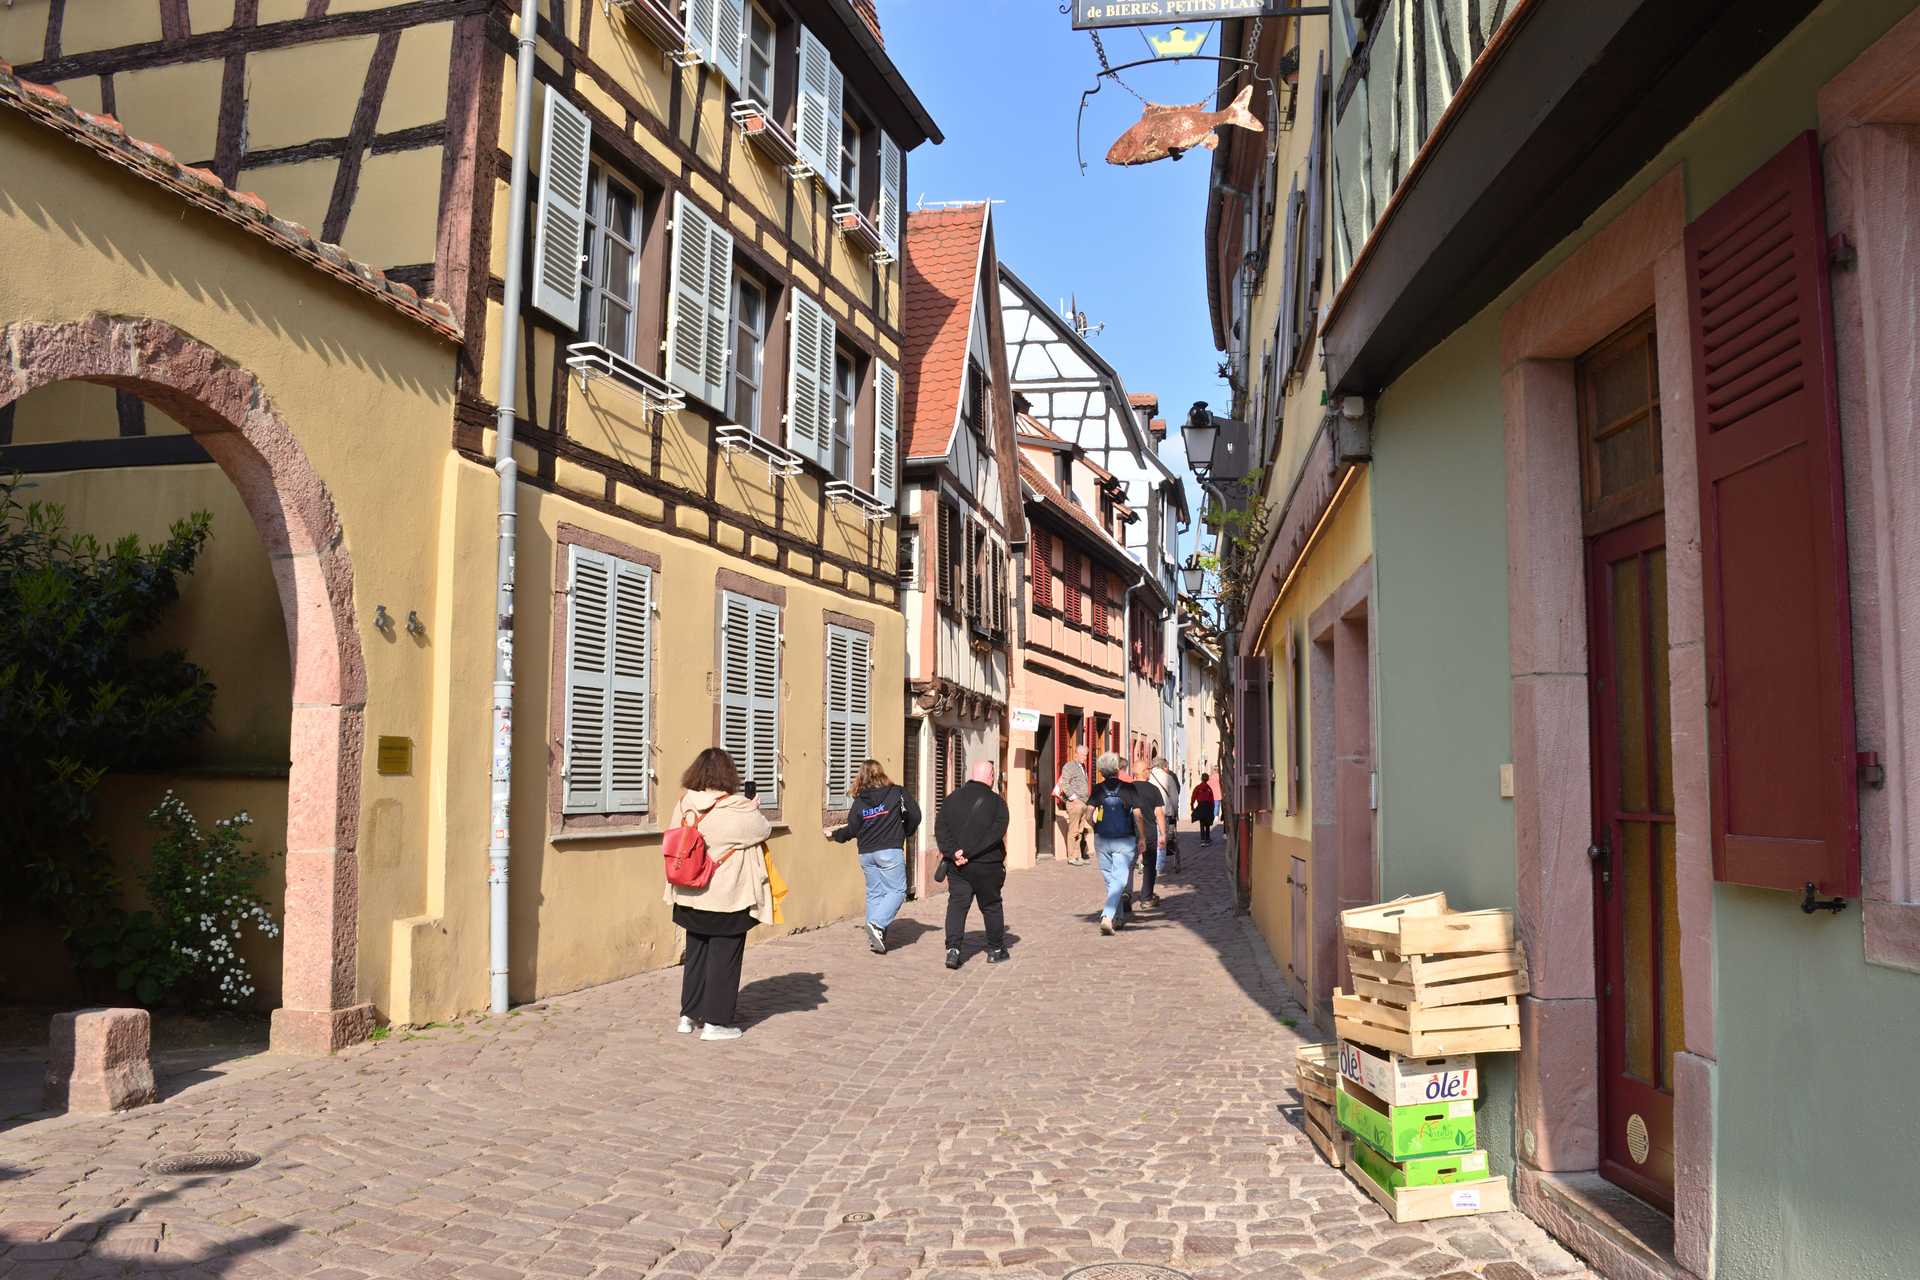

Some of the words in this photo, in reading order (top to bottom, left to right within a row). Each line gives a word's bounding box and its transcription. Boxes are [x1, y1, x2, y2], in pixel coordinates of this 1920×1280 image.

[1087, 6, 1102, 18] de
[1106, 2, 1162, 17] BIERES,
[1167, 0, 1216, 13] PETITS
